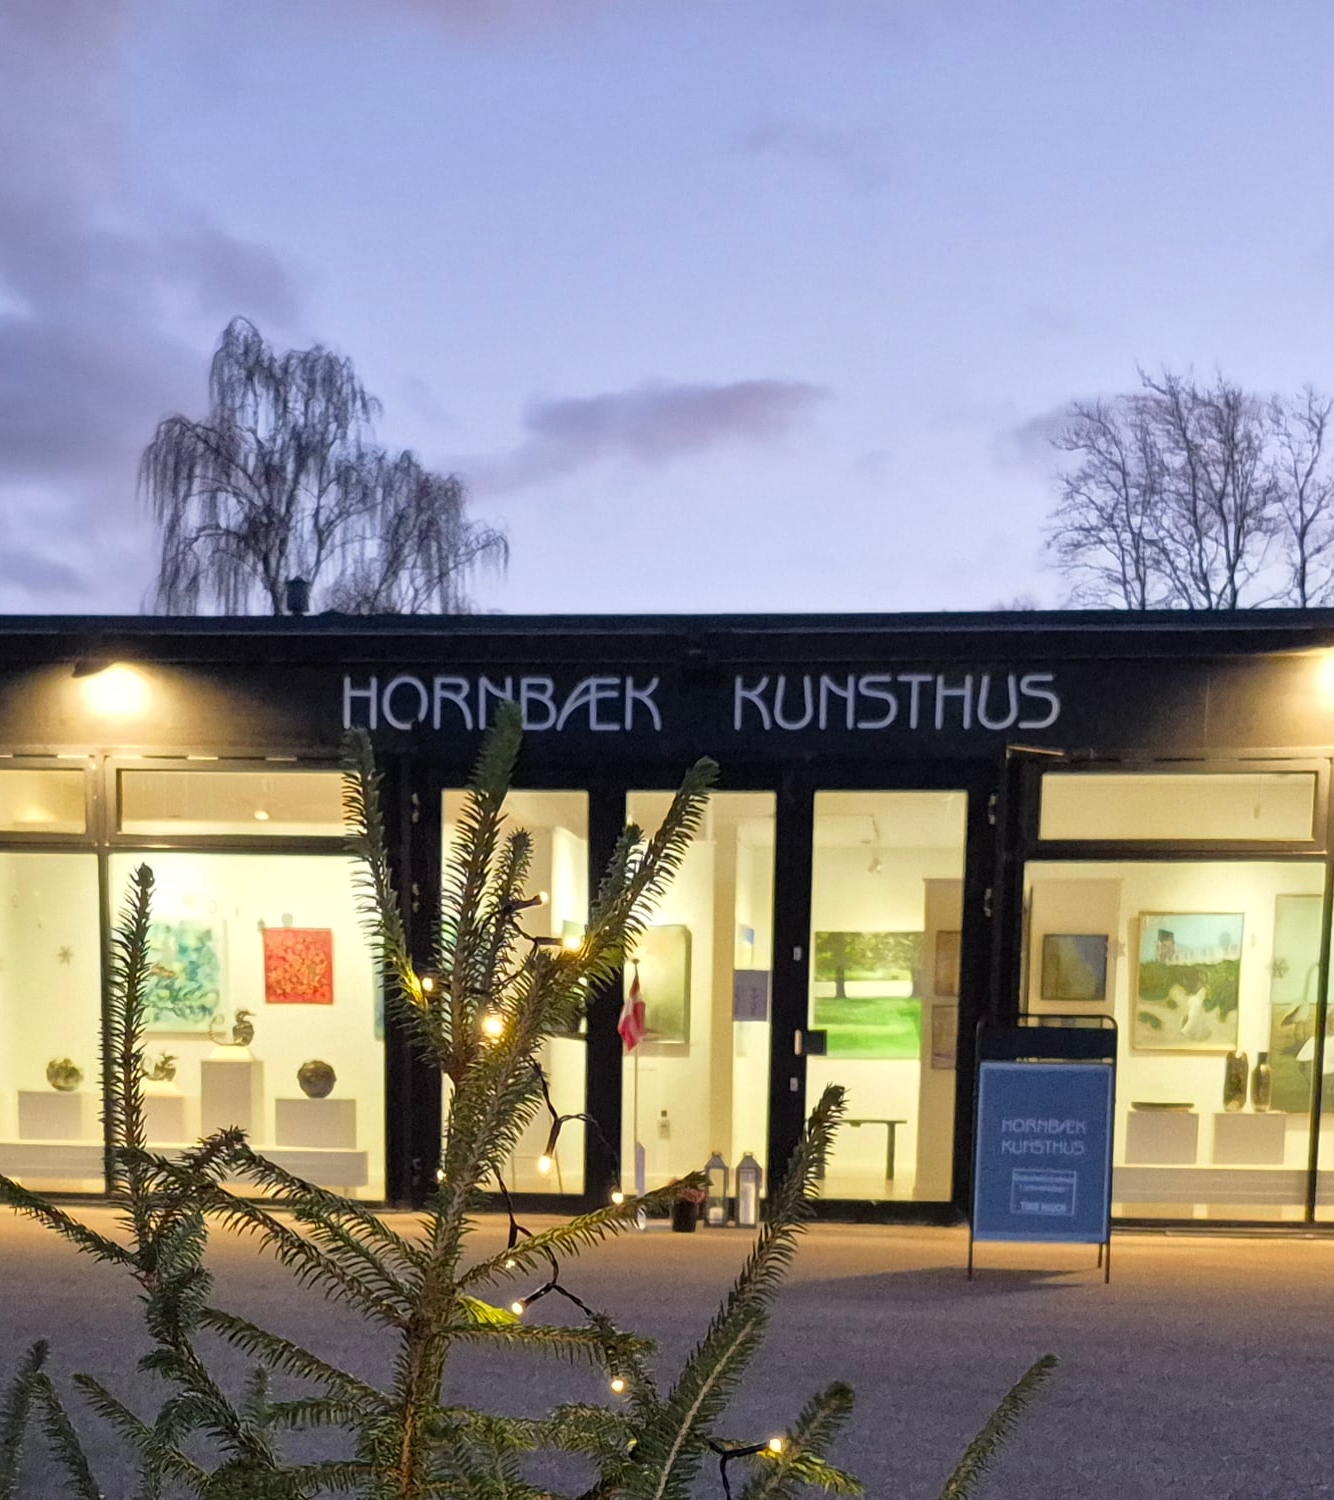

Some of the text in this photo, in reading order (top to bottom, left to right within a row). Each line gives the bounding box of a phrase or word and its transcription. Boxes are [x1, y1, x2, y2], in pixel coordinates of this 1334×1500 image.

[342, 674, 1061, 732] HORNBÆK KUNSTHUS
[1001, 1118, 1086, 1134] HORNBÆK
[1001, 1139, 1085, 1155] KUNSTHUS
